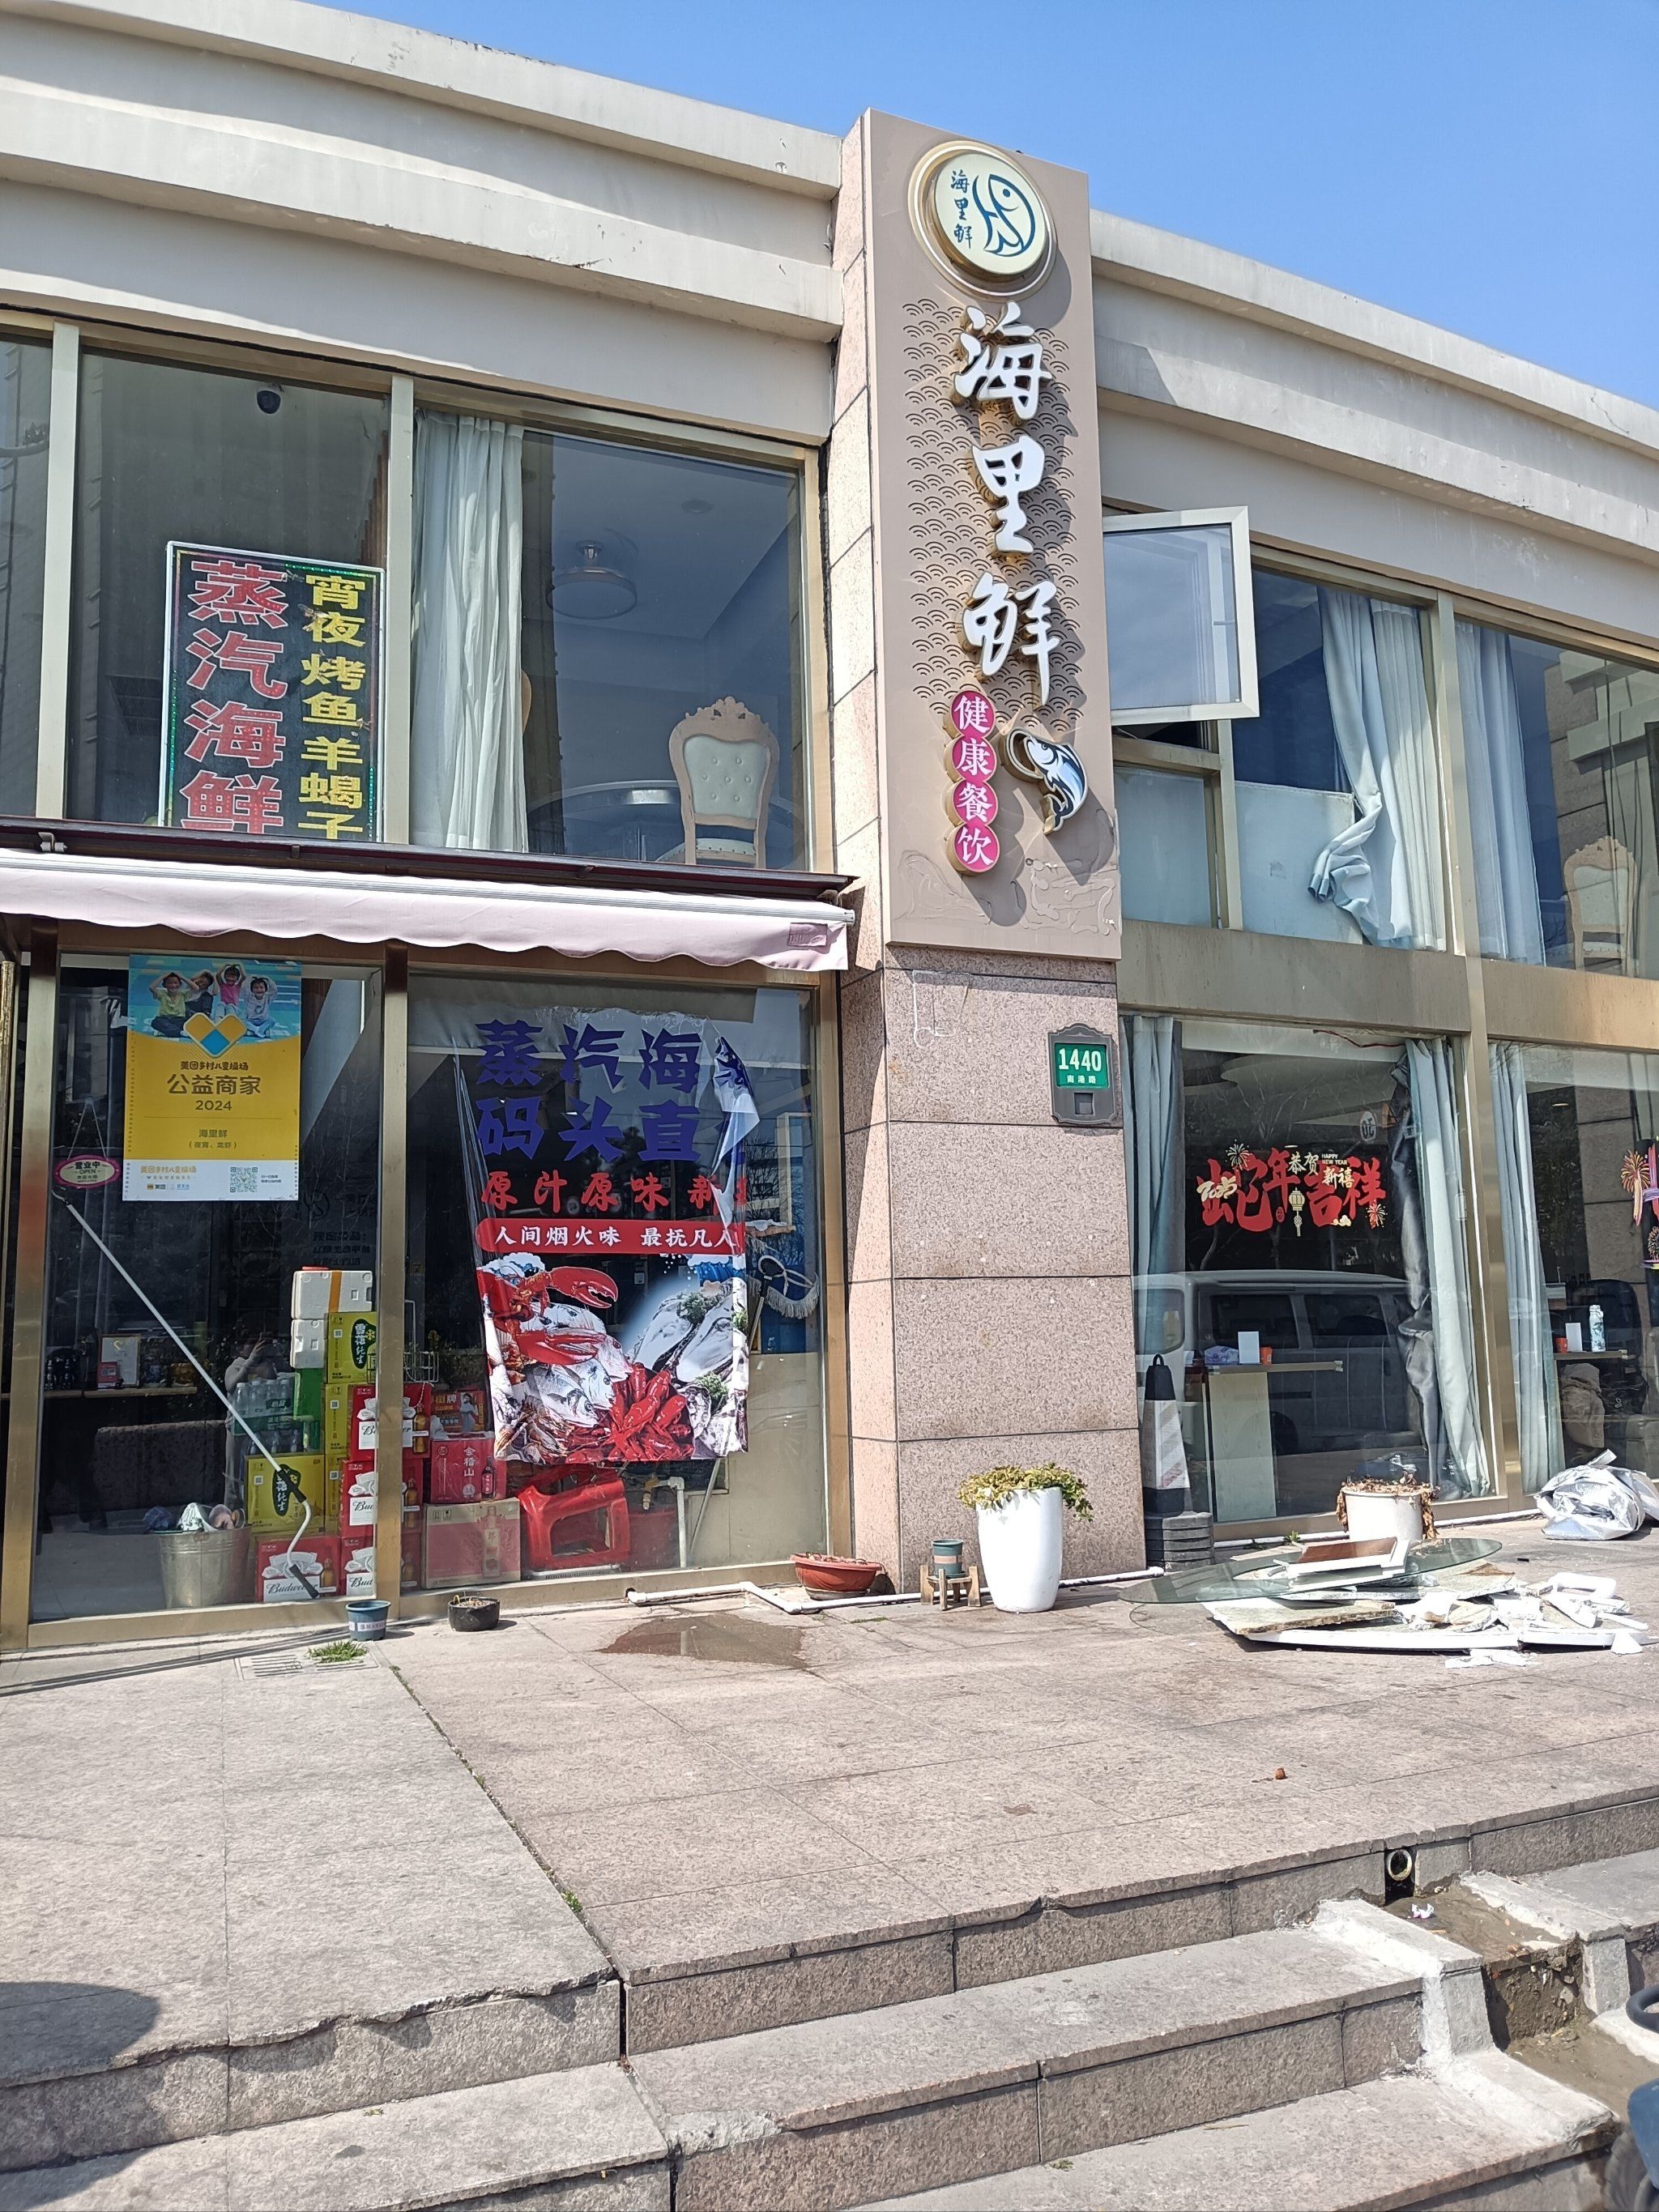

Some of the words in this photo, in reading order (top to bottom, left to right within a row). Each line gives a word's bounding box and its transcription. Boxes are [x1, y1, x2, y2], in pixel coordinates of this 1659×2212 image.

[950, 170, 973, 249] 海里鲜
[954, 300, 1061, 707] 海里鲜
[179, 560, 289, 834] 蒸汽海鲜
[297, 574, 366, 840] 宵夜烤鱼羊蝎子
[953, 695, 994, 866] 健康餐饮
[167, 1073, 261, 1095] 公益商家
[1059, 1047, 1102, 1072] 1440
[195, 1100, 232, 1110] 2024
[198, 1128, 228, 1138] 海里鲜
[476, 1095, 744, 1162] 码头直
[1196, 1147, 1386, 1231] 蛇年吉祥
[494, 1225, 622, 1247] 人间烟火味
